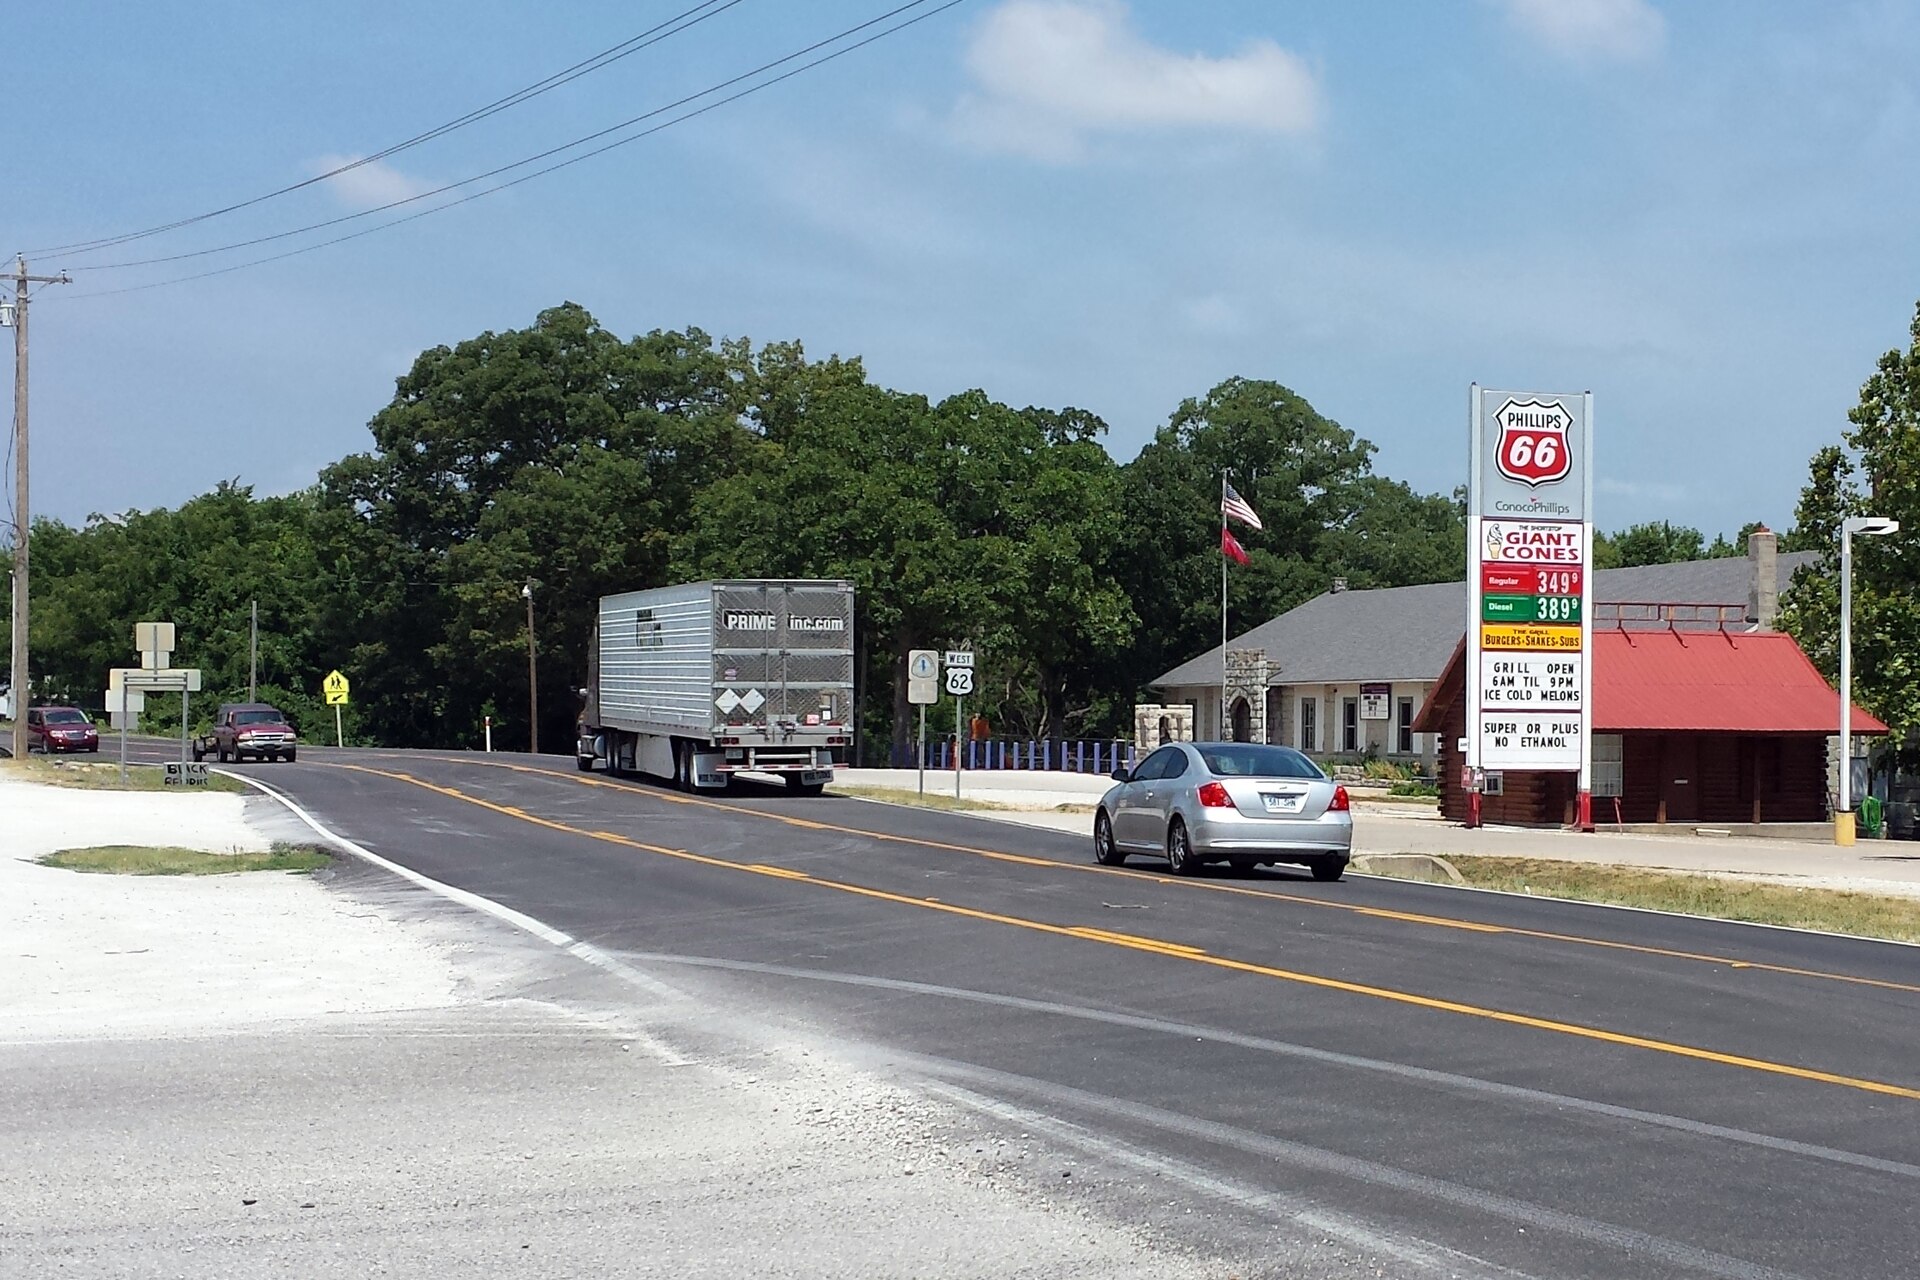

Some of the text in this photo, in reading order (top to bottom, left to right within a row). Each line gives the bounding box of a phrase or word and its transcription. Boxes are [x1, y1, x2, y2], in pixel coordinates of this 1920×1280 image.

[1508, 412, 1562, 429] PHILLIPS
[1509, 435, 1559, 468] 66
[1495, 501, 1570, 515] ConocoPhillips
[1506, 532, 1576, 546] GIANT
[1502, 546, 1579, 560] CONES
[1488, 576, 1519, 586] Regular
[1488, 602, 1513, 611] Diesel
[725, 612, 844, 631] PRIME inc.com
[948, 654, 970, 664] WEST
[1494, 662, 1575, 674] GRILL OPEN
[950, 673, 969, 690] 62
[1492, 676, 1573, 688] 6AM TIL 9PM
[1485, 689, 1580, 701] ICE COLD MELONS
[1484, 722, 1579, 734] SUPER OR PLUS
[1495, 737, 1567, 748] NO ETHANOL
[167, 764, 208, 775] BLCK
